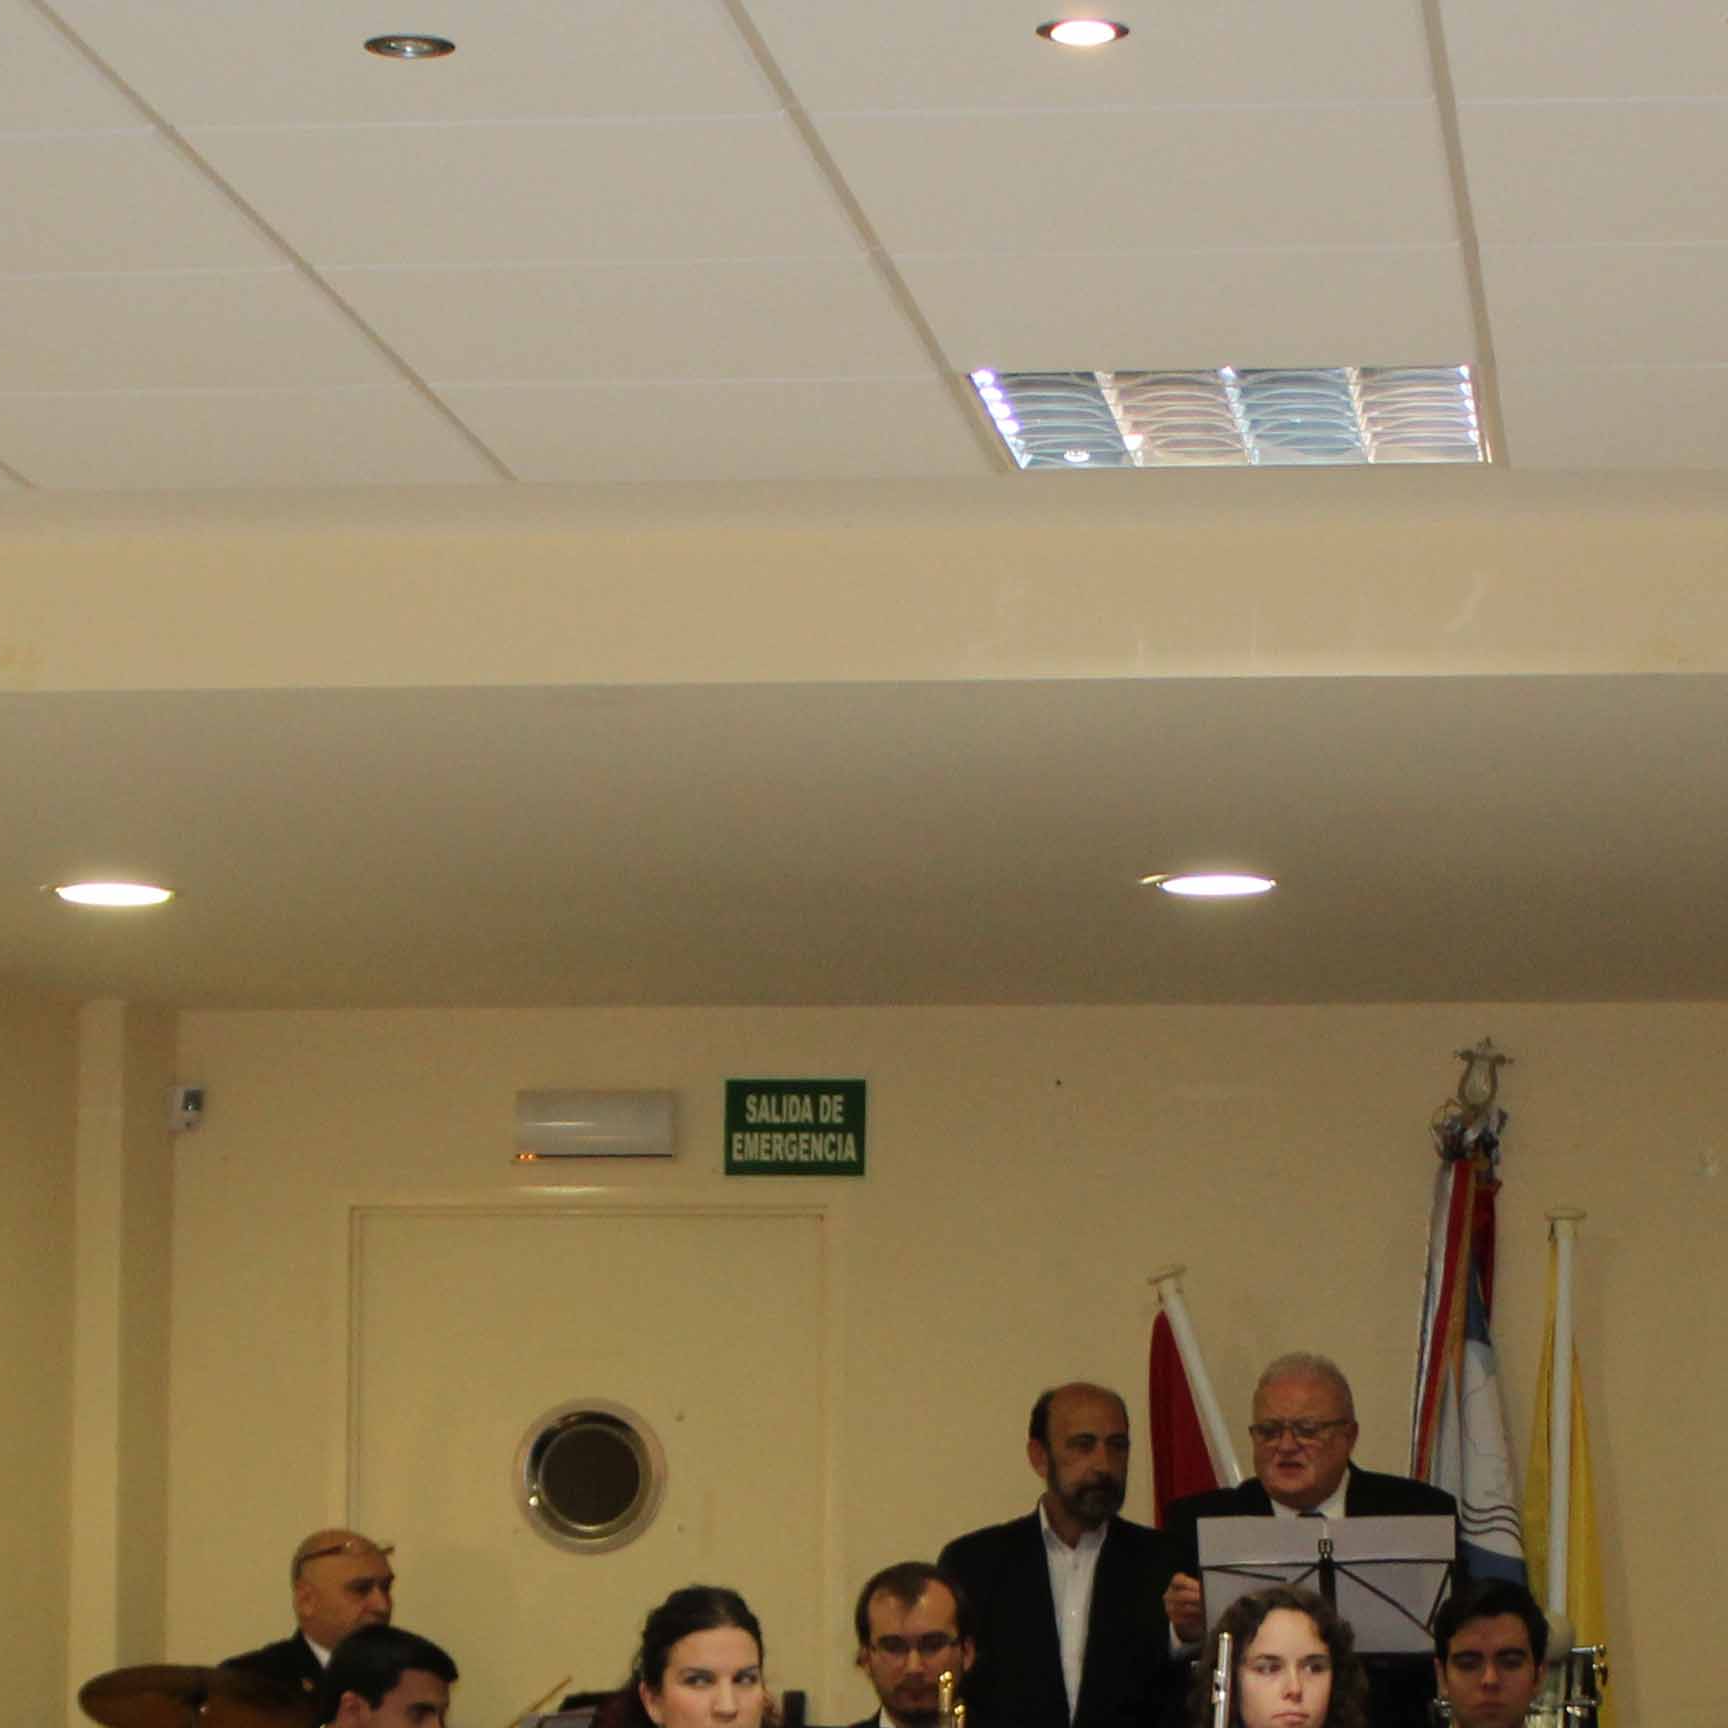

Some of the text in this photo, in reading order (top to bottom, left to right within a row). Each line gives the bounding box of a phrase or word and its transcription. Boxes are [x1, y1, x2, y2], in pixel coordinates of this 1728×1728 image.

[745, 1094, 844, 1124] SALIDA DE
[731, 1132, 857, 1162] EMERGENCIA
